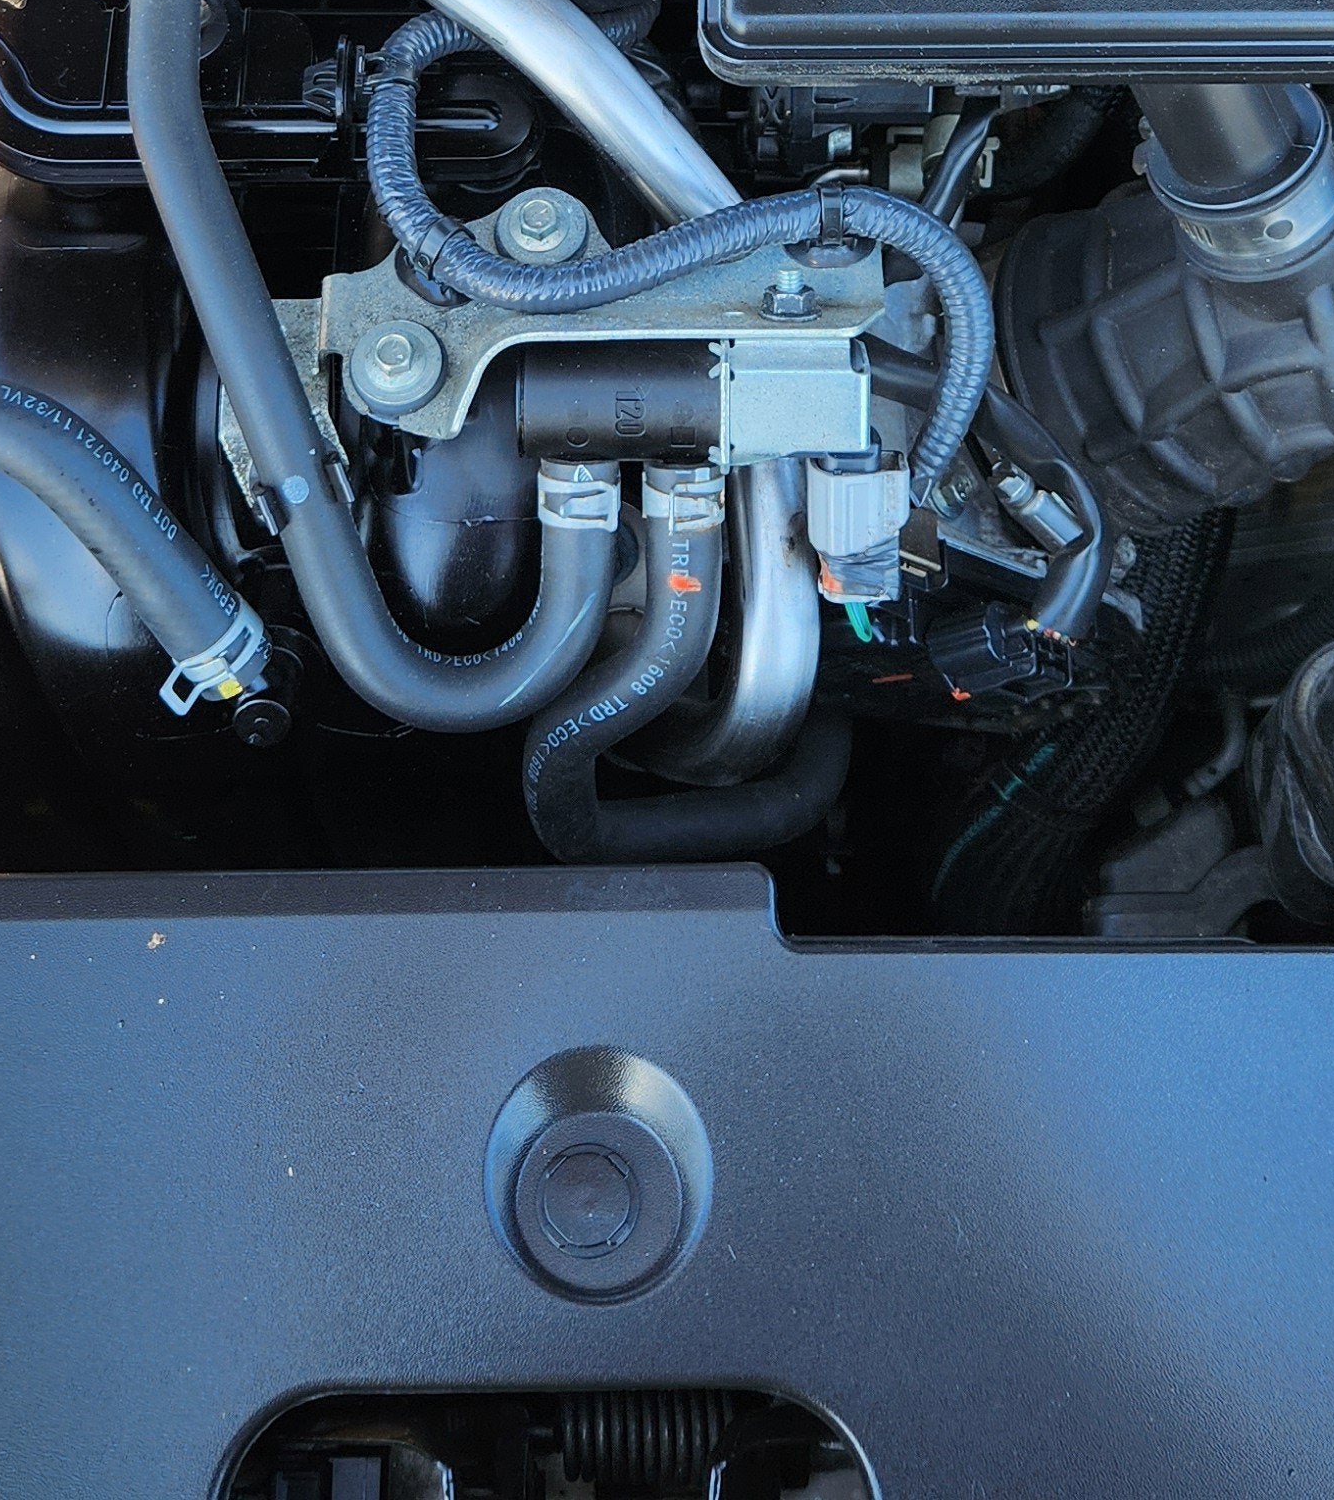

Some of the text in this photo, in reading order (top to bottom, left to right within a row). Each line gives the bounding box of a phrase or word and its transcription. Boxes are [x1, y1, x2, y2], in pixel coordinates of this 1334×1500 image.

[615, 387, 650, 438] 120
[75, 427, 131, 484] 040721
[152, 510, 180, 542] DOT
